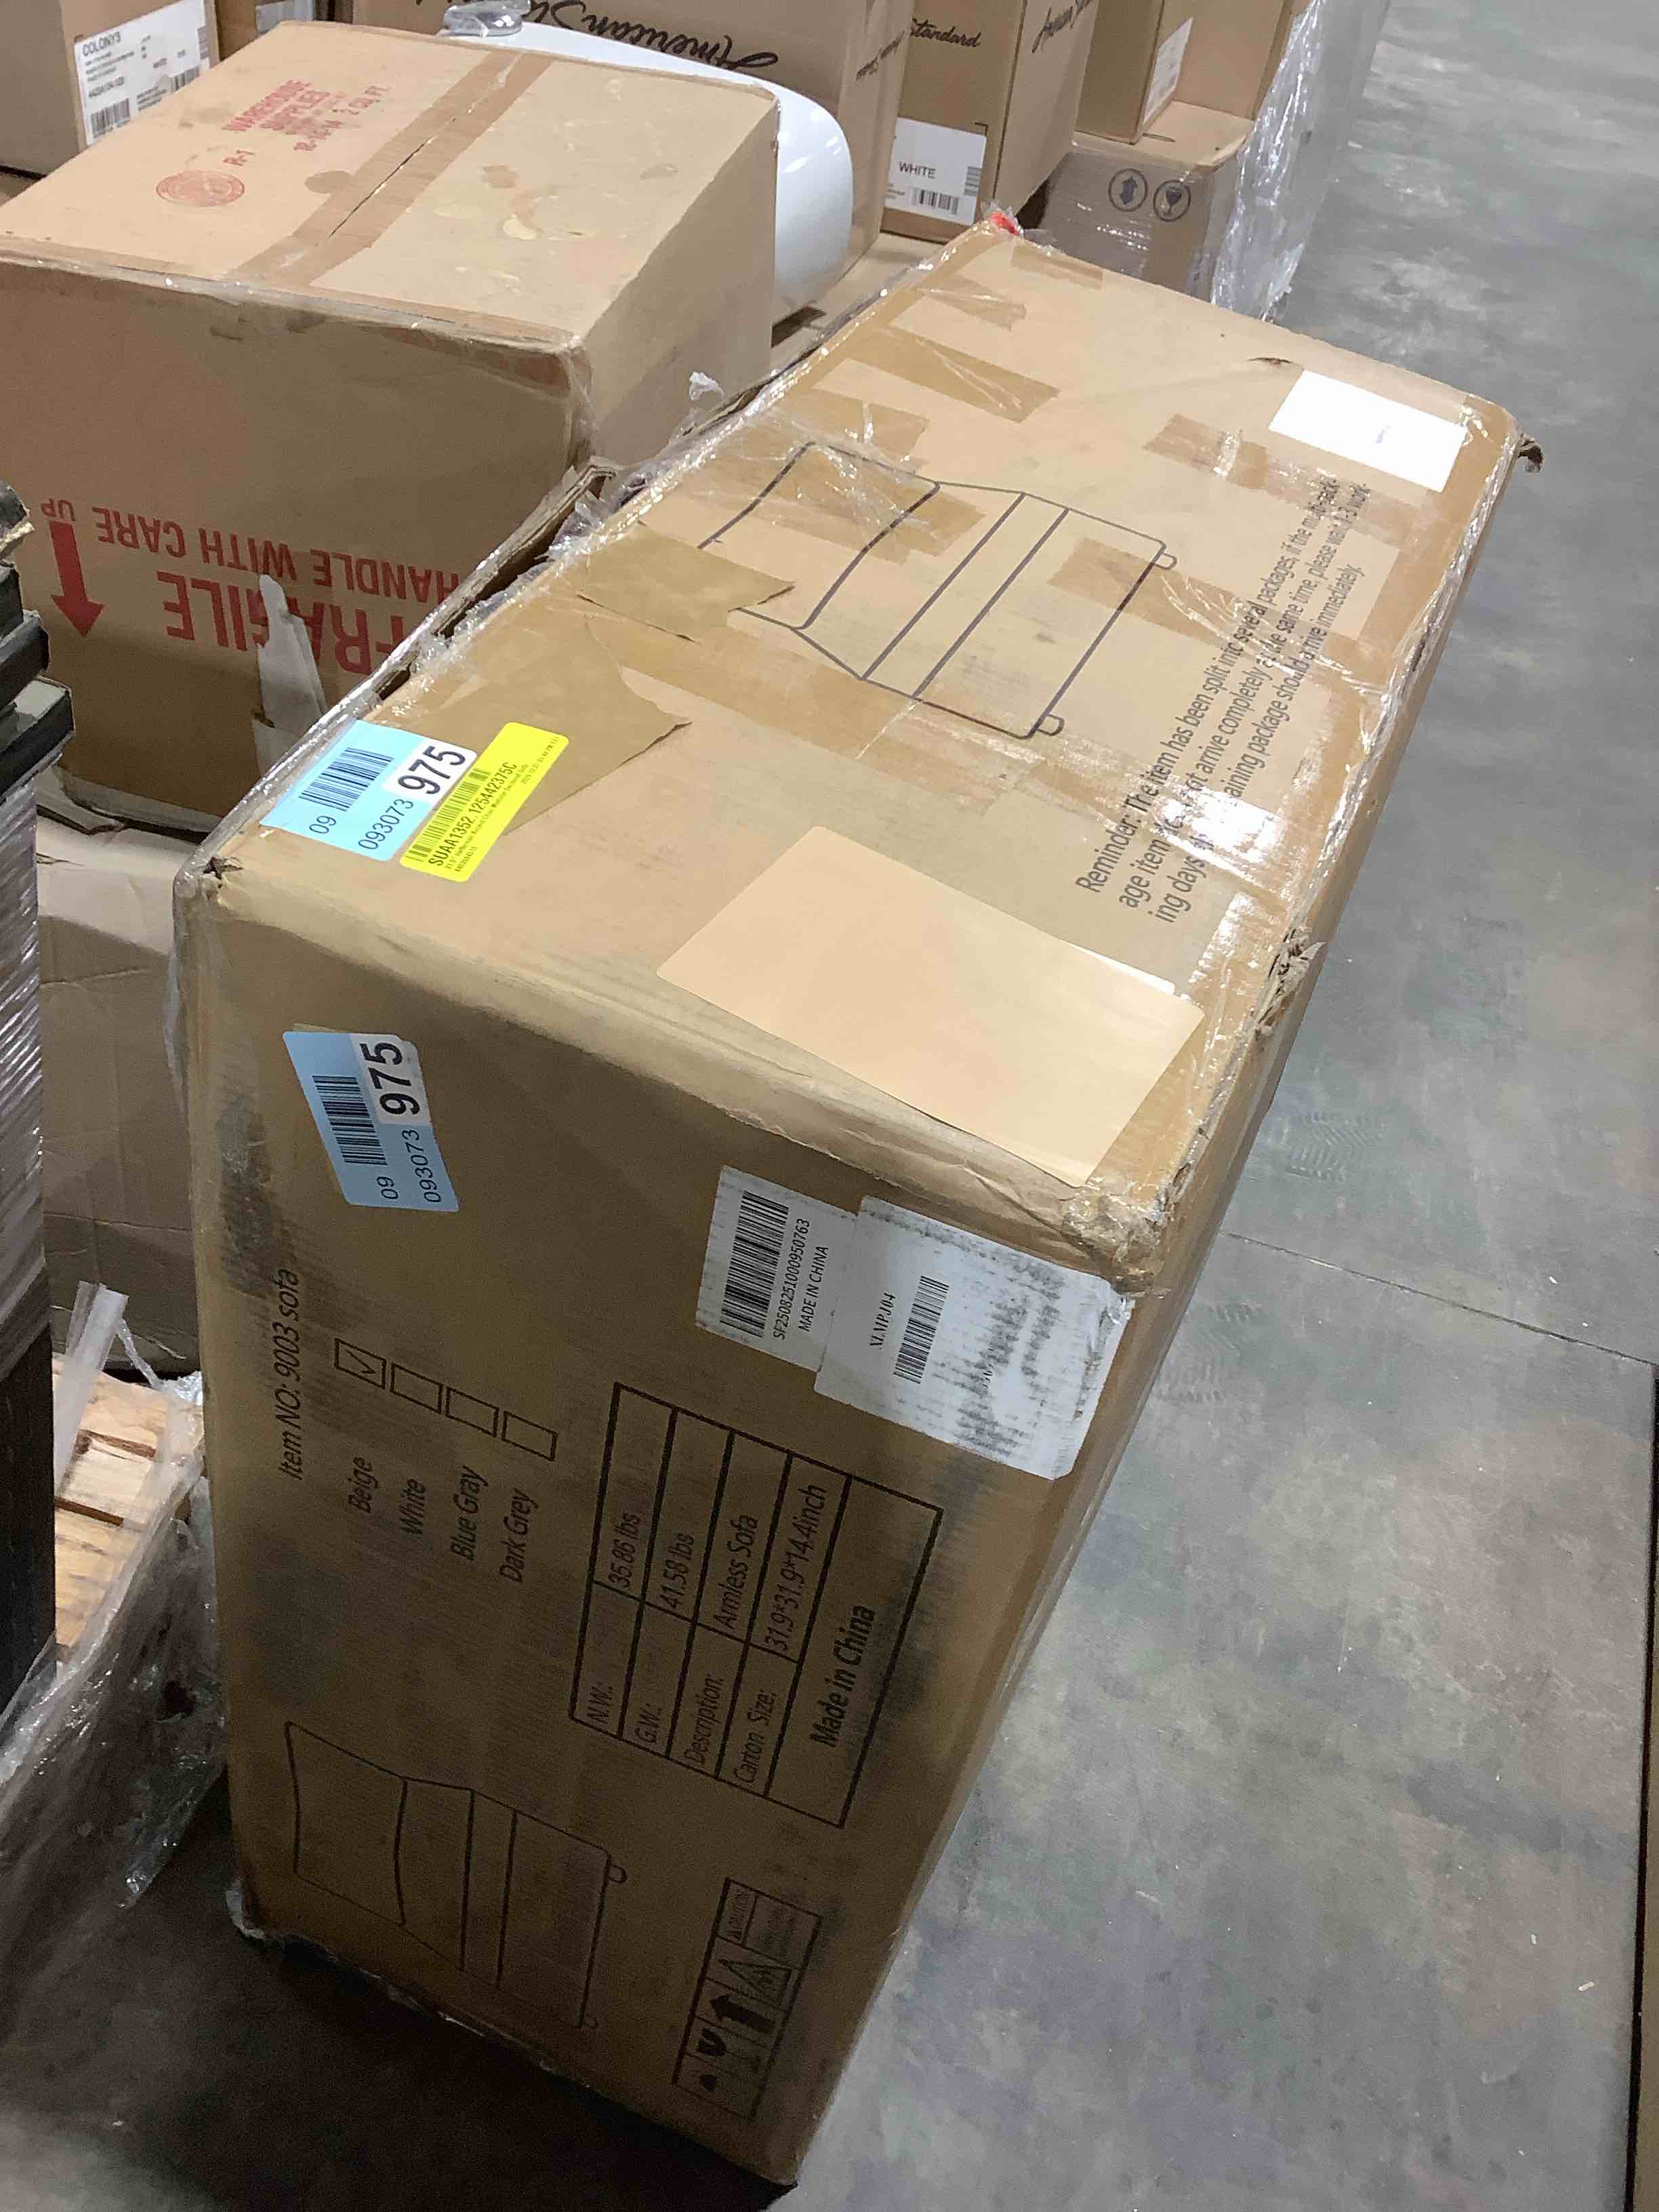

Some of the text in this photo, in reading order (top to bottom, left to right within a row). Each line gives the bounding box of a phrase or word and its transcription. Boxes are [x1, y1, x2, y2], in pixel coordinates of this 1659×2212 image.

[899, 161, 937, 179] WHITE
[41, 499, 76, 522] UP
[91, 506, 459, 604] HANDLE WITH CARE
[1288, 528, 1312, 546] the
[1307, 546, 1338, 580] please
[1233, 600, 1267, 643] several
[1276, 602, 1304, 633] same
[1203, 665, 1231, 695] split
[1218, 669, 1274, 735] completely
[1176, 693, 1210, 726] been
[1160, 726, 1194, 752] has
[1189, 734, 1229, 774] arrive
[397, 745, 466, 795] 975
[1141, 752, 1179, 787] item
[1123, 783, 1159, 813] The
[1149, 893, 1191, 923] ing
[1248, 699, 1289, 756] package
[309, 815, 337, 835] 09
[358, 798, 414, 851] 093073
[1076, 815, 1140, 893] Reminder:
[1130, 840, 1170, 875] item
[1118, 875, 1151, 907] age
[359, 1042, 420, 1115] 975
[377, 1176, 398, 1200] 09
[402, 1129, 441, 1203] 093073
[773, 1218, 809, 1340] SF2508251000950763
[798, 1246, 828, 1332] MADE IN CHINA
[869, 1292, 896, 1349] XLMPJ04
[272, 1268, 302, 1480] Item NO: 9003 sofa
[348, 1456, 380, 1514] Beige
[401, 1478, 426, 1536] White
[451, 1465, 488, 1561] Blue Gray
[499, 1488, 539, 1584] Dark Grey
[618, 1513, 641, 1540] lbs
[669, 1532, 695, 1561] lbs
[659, 1561, 689, 1610] 41.58
[684, 1514, 760, 1765] Description: Armless Sofa
[810, 1605, 876, 1747] Made in China
[748, 1689, 777, 1725] Size:
[733, 1731, 765, 1783] Carton
